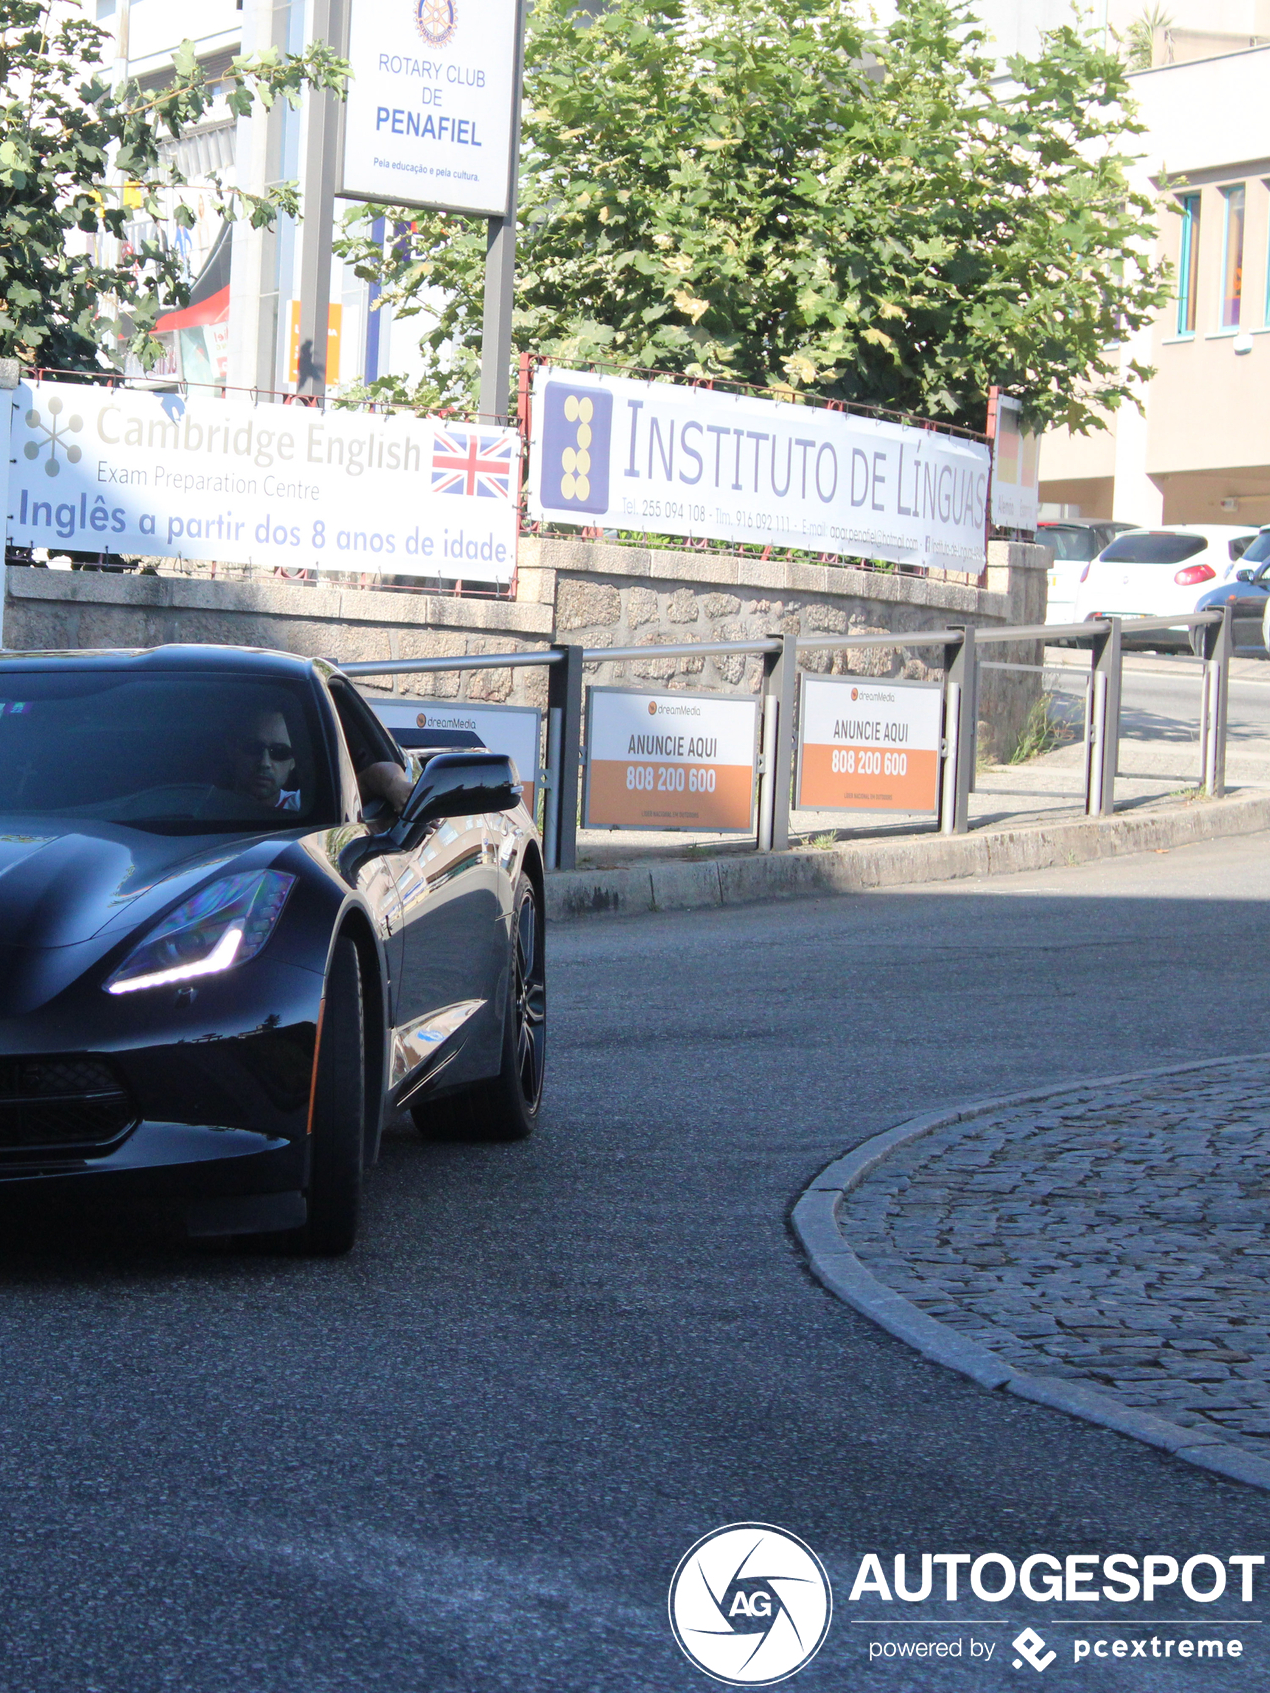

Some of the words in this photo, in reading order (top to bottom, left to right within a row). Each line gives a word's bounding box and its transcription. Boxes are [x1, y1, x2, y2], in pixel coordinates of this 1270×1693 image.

[378, 53, 443, 80] ROTARY
[446, 65, 486, 88] CLUB
[422, 87, 443, 107] DE
[376, 106, 482, 147] PENAFIEL
[373, 157, 390, 169] Pela
[391, 160, 428, 174] educação
[429, 167, 434, 175] e
[435, 167, 451, 178] pela
[96, 403, 295, 468] Cambridge
[307, 423, 421, 477] English
[623, 398, 838, 504] INSTITUTO
[850, 447, 887, 512] DE
[897, 439, 987, 530] LÍNGUAS
[97, 460, 147, 486] Exam
[154, 465, 257, 494] Preparation
[263, 475, 320, 500] Centre
[19, 489, 126, 539] Inglês
[138, 513, 156, 535] a
[167, 510, 245, 545] partir
[254, 513, 301, 547] dos
[311, 519, 326, 549] 8
[336, 529, 396, 554] anos
[405, 525, 434, 556] de
[642, 499, 662, 518] 255
[664, 501, 684, 520] 094
[688, 503, 706, 522] 108
[736, 510, 753, 528] 916
[755, 512, 773, 531] 092
[776, 515, 790, 533] 111
[859, 690, 895, 702] dreamMedia
[427, 717, 476, 730] dreamMedia
[658, 704, 701, 716] dreamMedia
[833, 719, 881, 741] ANUNCIE
[883, 722, 909, 743] AQUI
[628, 734, 684, 757] ANUNCIE
[687, 737, 717, 758] AQUI
[831, 749, 855, 774] 808
[857, 751, 881, 775] 200
[884, 752, 907, 776] 600
[626, 765, 654, 790] 808
[657, 766, 685, 792] 200
[688, 768, 716, 793] 600
